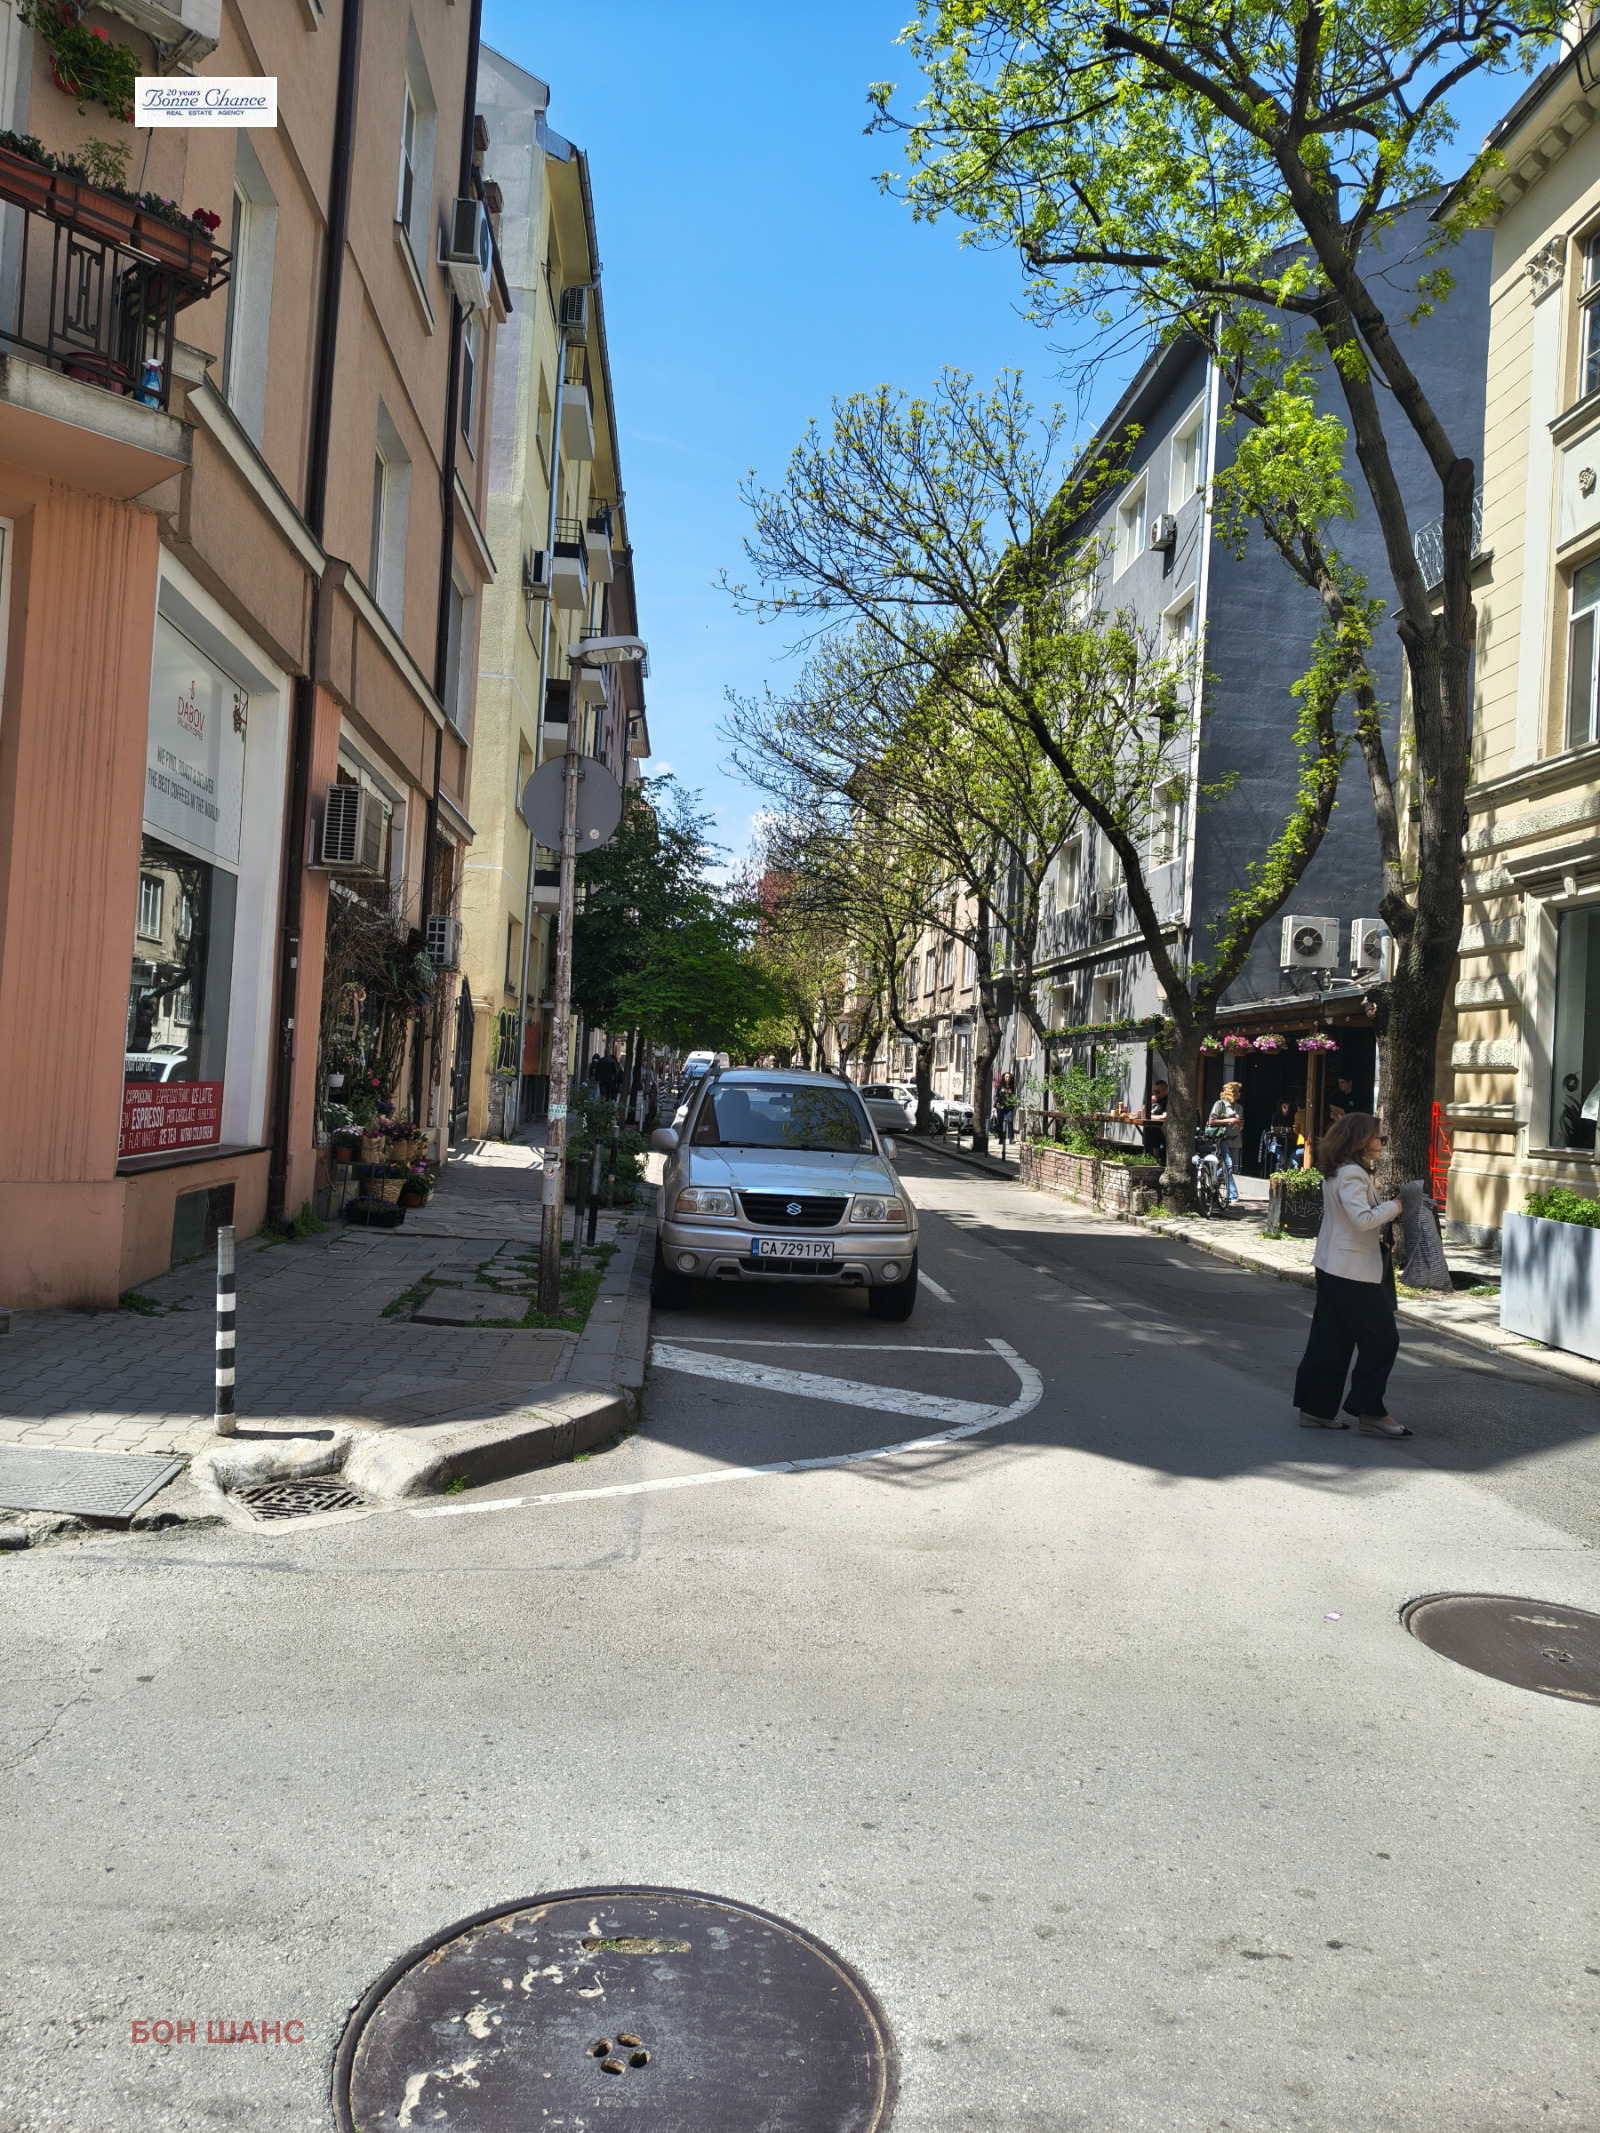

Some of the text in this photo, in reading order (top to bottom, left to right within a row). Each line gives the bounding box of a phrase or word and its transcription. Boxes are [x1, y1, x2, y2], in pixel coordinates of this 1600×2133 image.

[177, 696, 205, 731] DABOV
[157, 745, 165, 766] WE
[147, 767, 158, 789] THE
[157, 773, 171, 795] BEST
[125, 1089, 153, 1105] CAPPUCCINO
[191, 1088, 199, 1104] ICE
[199, 1087, 213, 1104] LATTE
[121, 1112, 131, 1129] EW
[131, 1106, 165, 1130] ESPRESSO
[166, 1108, 176, 1124] HOT
[128, 1132, 142, 1150] FLAT
[141, 1130, 156, 1148] WHITE
[158, 1128, 167, 1145] ICE
[167, 1127, 177, 1144] TEA
